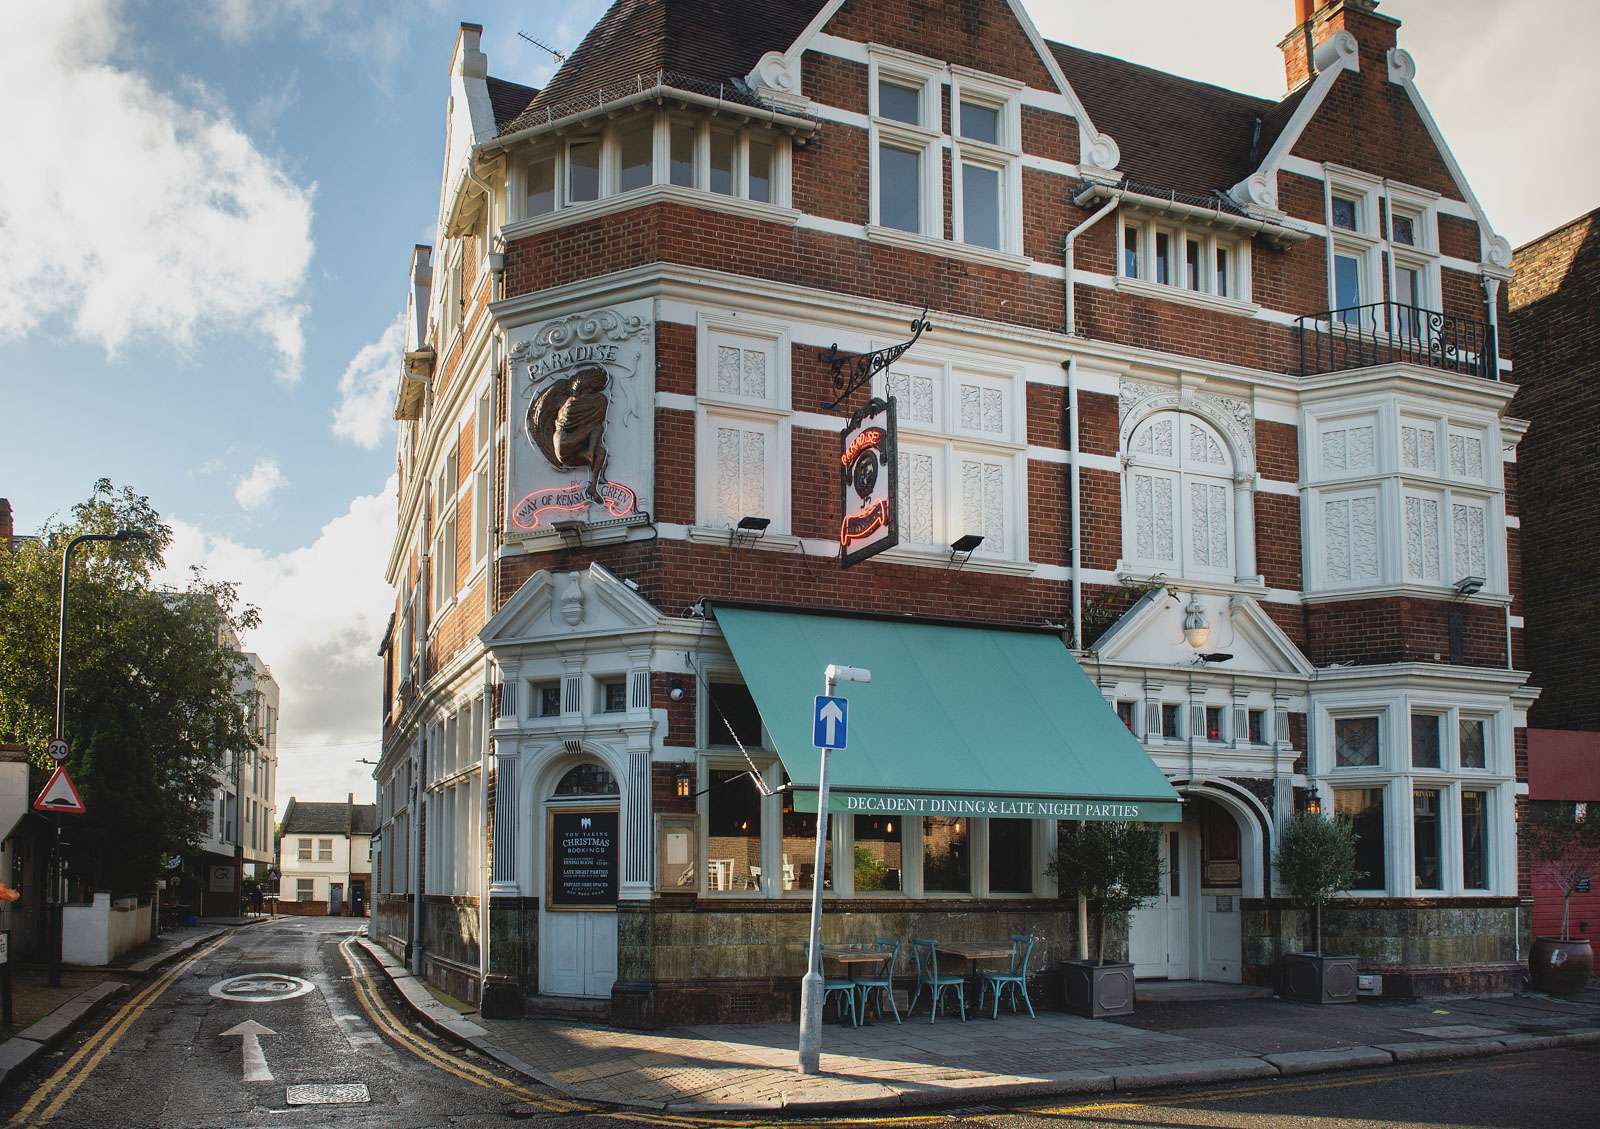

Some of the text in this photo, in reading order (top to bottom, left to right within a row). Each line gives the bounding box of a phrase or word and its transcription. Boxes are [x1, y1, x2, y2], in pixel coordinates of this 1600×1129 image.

[528, 344, 619, 381] PARADISE
[841, 431, 880, 466] PARADISE
[518, 499, 538, 518] WAY
[541, 495, 553, 506] OF
[600, 485, 630, 503] GREEN
[50, 744, 67, 755] 20
[847, 796, 1139, 818] DECADENT DINING & LATE NIGHT PARTIES
[563, 838, 609, 847] CHRISTMAS
